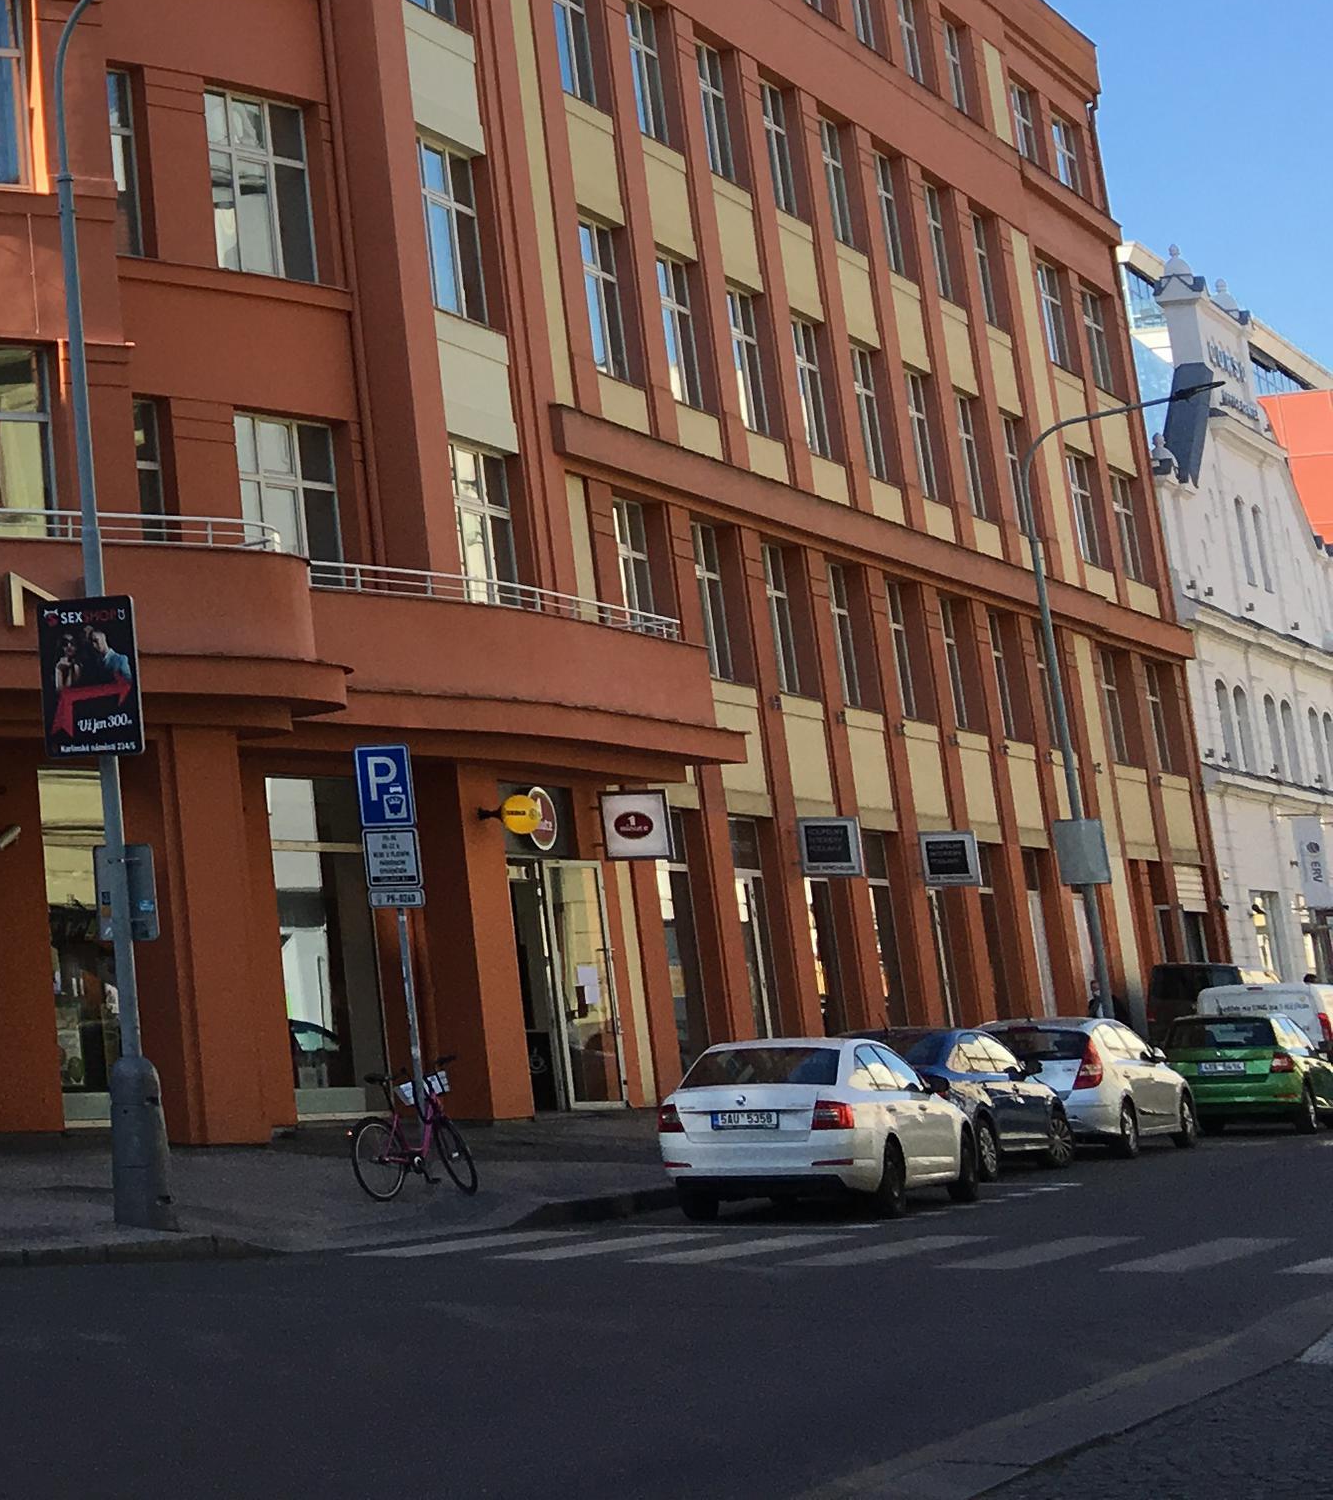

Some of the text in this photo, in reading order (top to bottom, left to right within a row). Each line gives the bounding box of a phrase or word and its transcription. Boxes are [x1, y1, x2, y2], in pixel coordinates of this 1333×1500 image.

[366, 756, 398, 801] P
[627, 814, 636, 826] 1
[1310, 860, 1324, 884] ERV
[720, 1112, 740, 1125] 5AU
